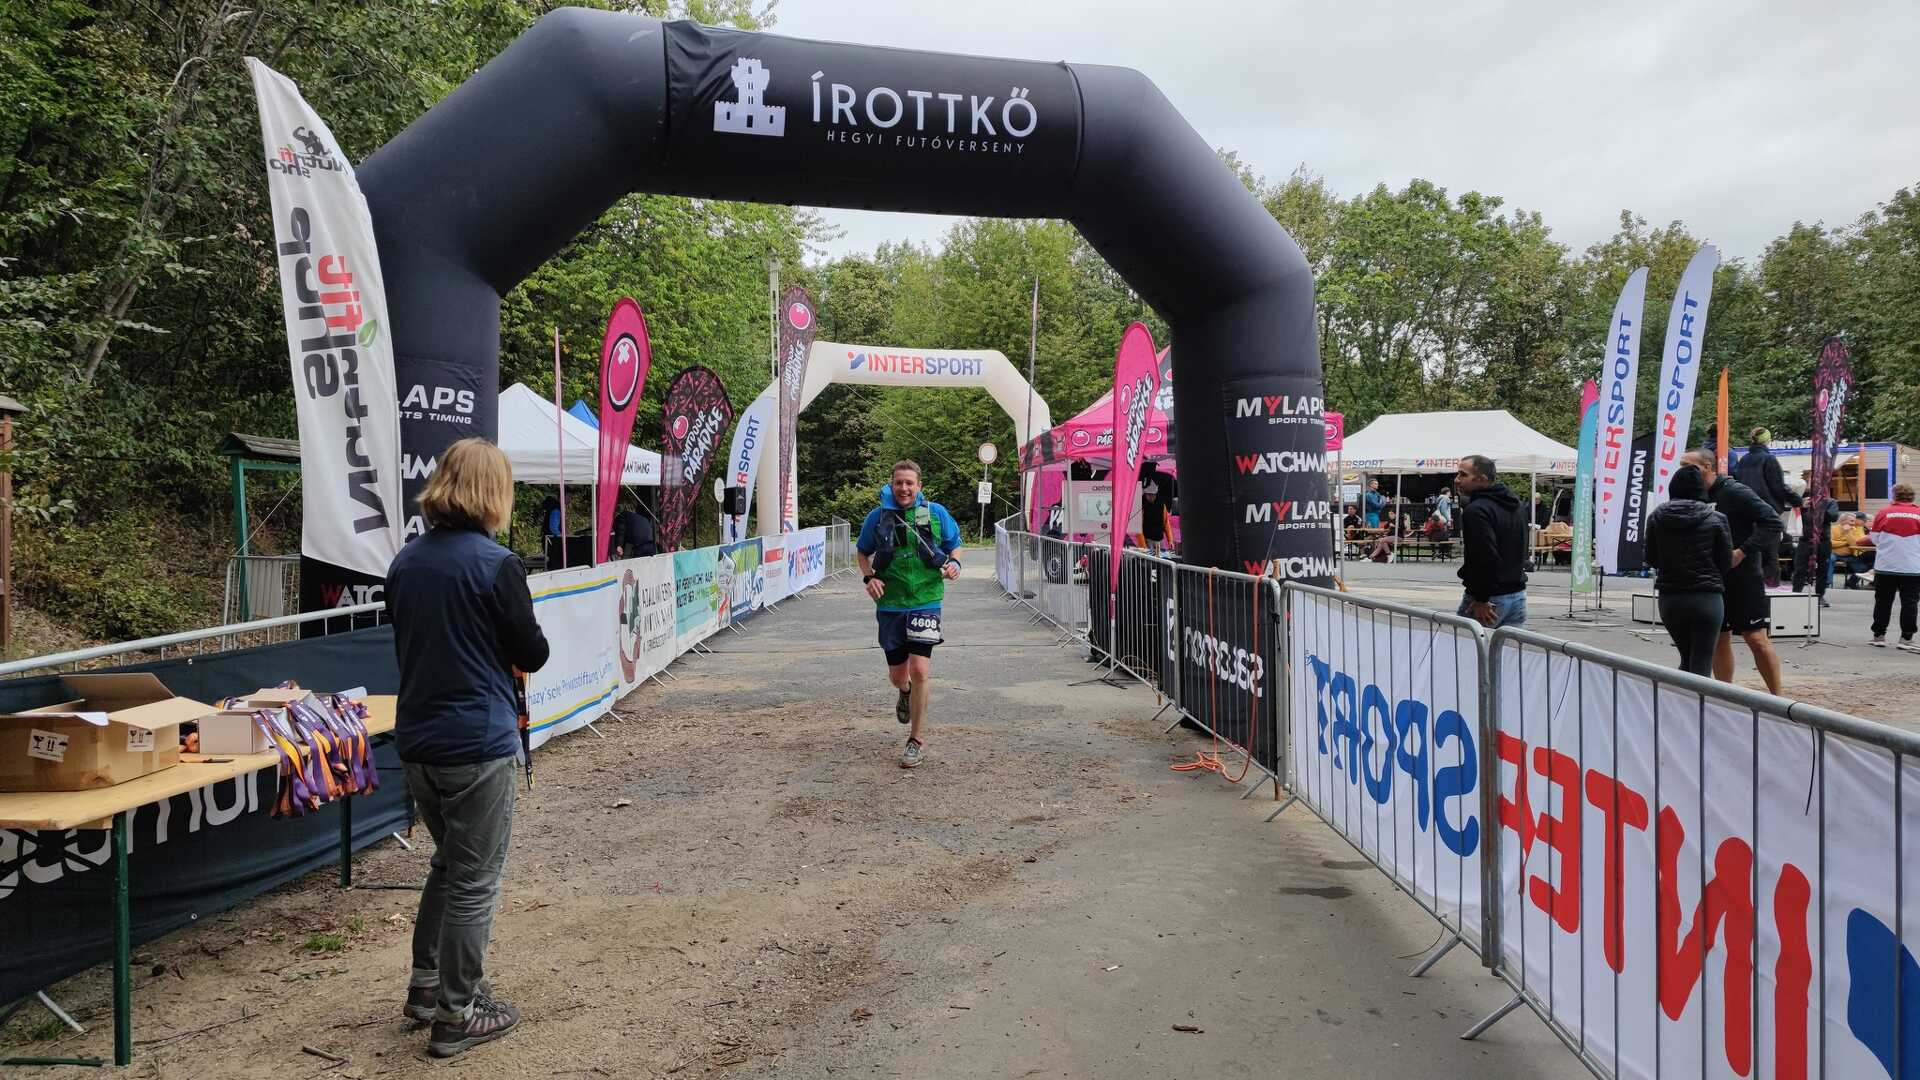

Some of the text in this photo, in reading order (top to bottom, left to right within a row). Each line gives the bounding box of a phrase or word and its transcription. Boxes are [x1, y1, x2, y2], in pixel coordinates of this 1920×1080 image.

[811, 70, 1038, 138] ÍROTTKŐ
[827, 130, 1026, 155] HEGYI FUTÓVERSENY
[868, 352, 983, 375] INTERSPORT
[402, 384, 474, 413] APS
[429, 413, 472, 424] TIMING
[682, 410, 706, 462] OUTDOOR
[684, 406, 723, 484] PARADISE
[1626, 450, 1647, 543] SALOMON
[1278, 522, 1315, 530] SPORTS
[911, 617, 938, 629] 4608
